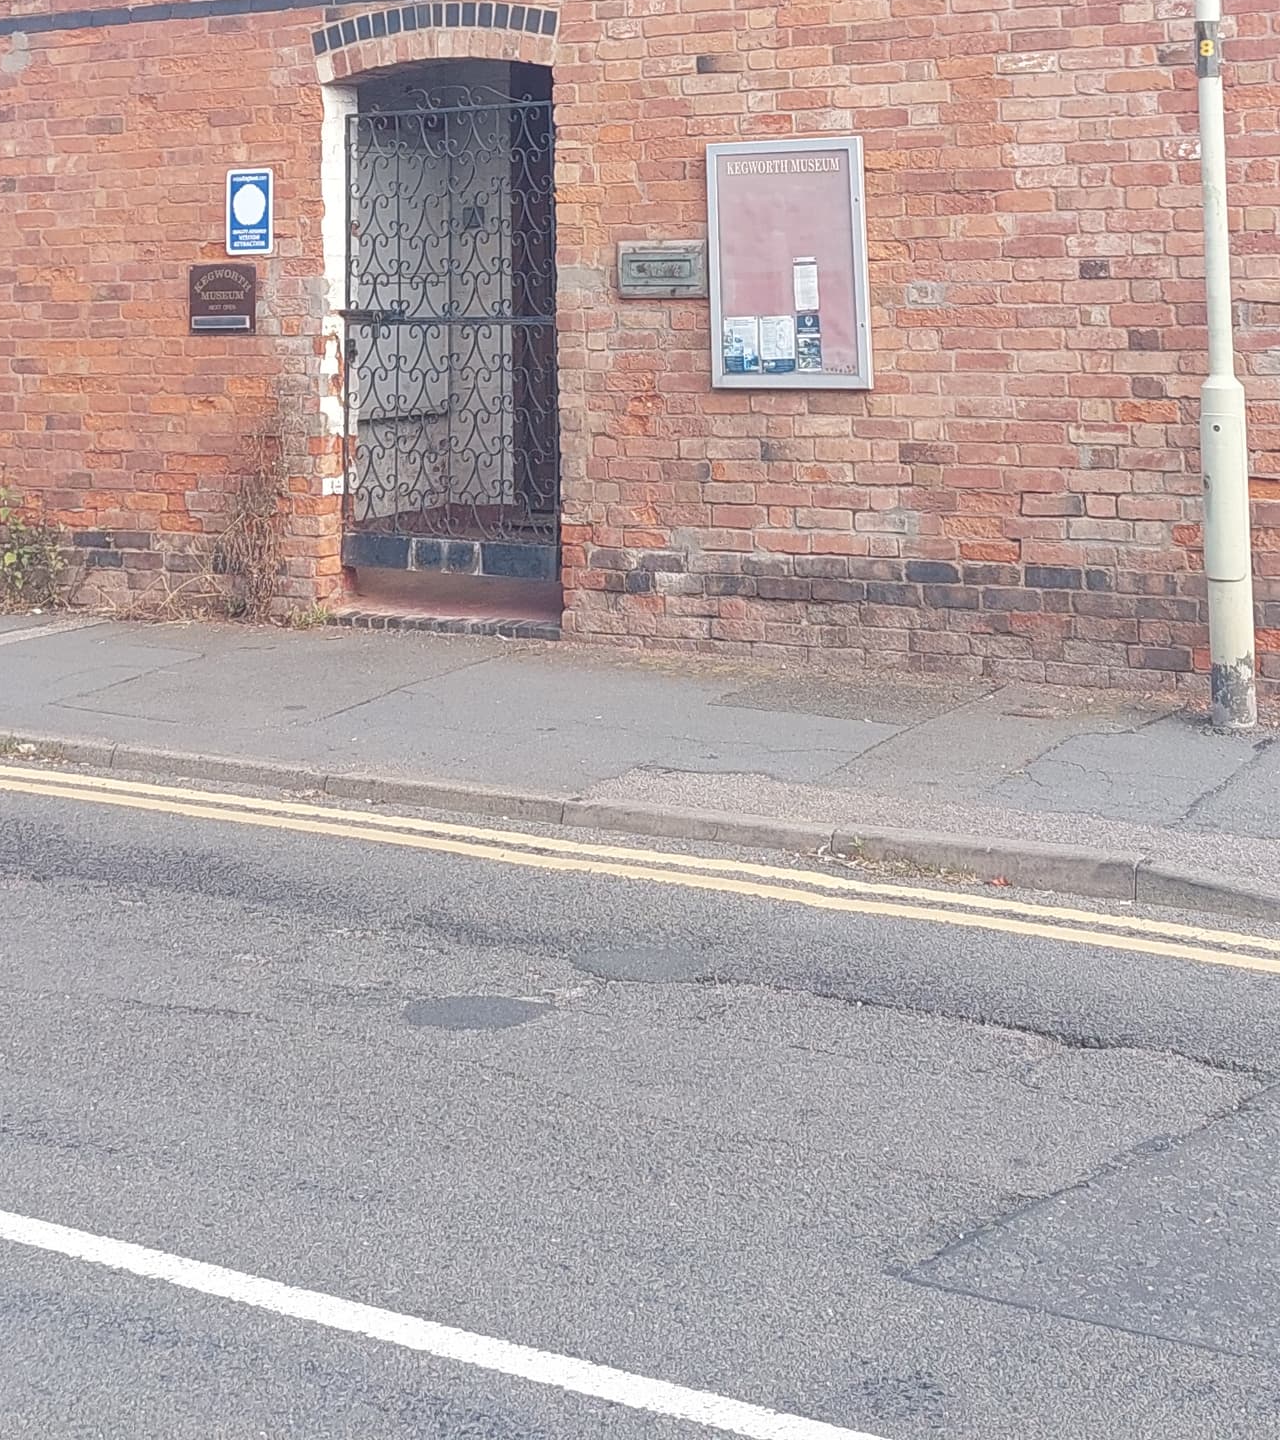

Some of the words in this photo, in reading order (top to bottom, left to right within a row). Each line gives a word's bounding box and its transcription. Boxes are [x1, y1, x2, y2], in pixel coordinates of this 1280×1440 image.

[1200, 39, 1214, 57] 8
[726, 159, 788, 175] KEGWORTH
[791, 157, 840, 173] MUSEUM
[194, 268, 252, 293] KEGWORTH
[201, 290, 245, 300] MUSEUM
